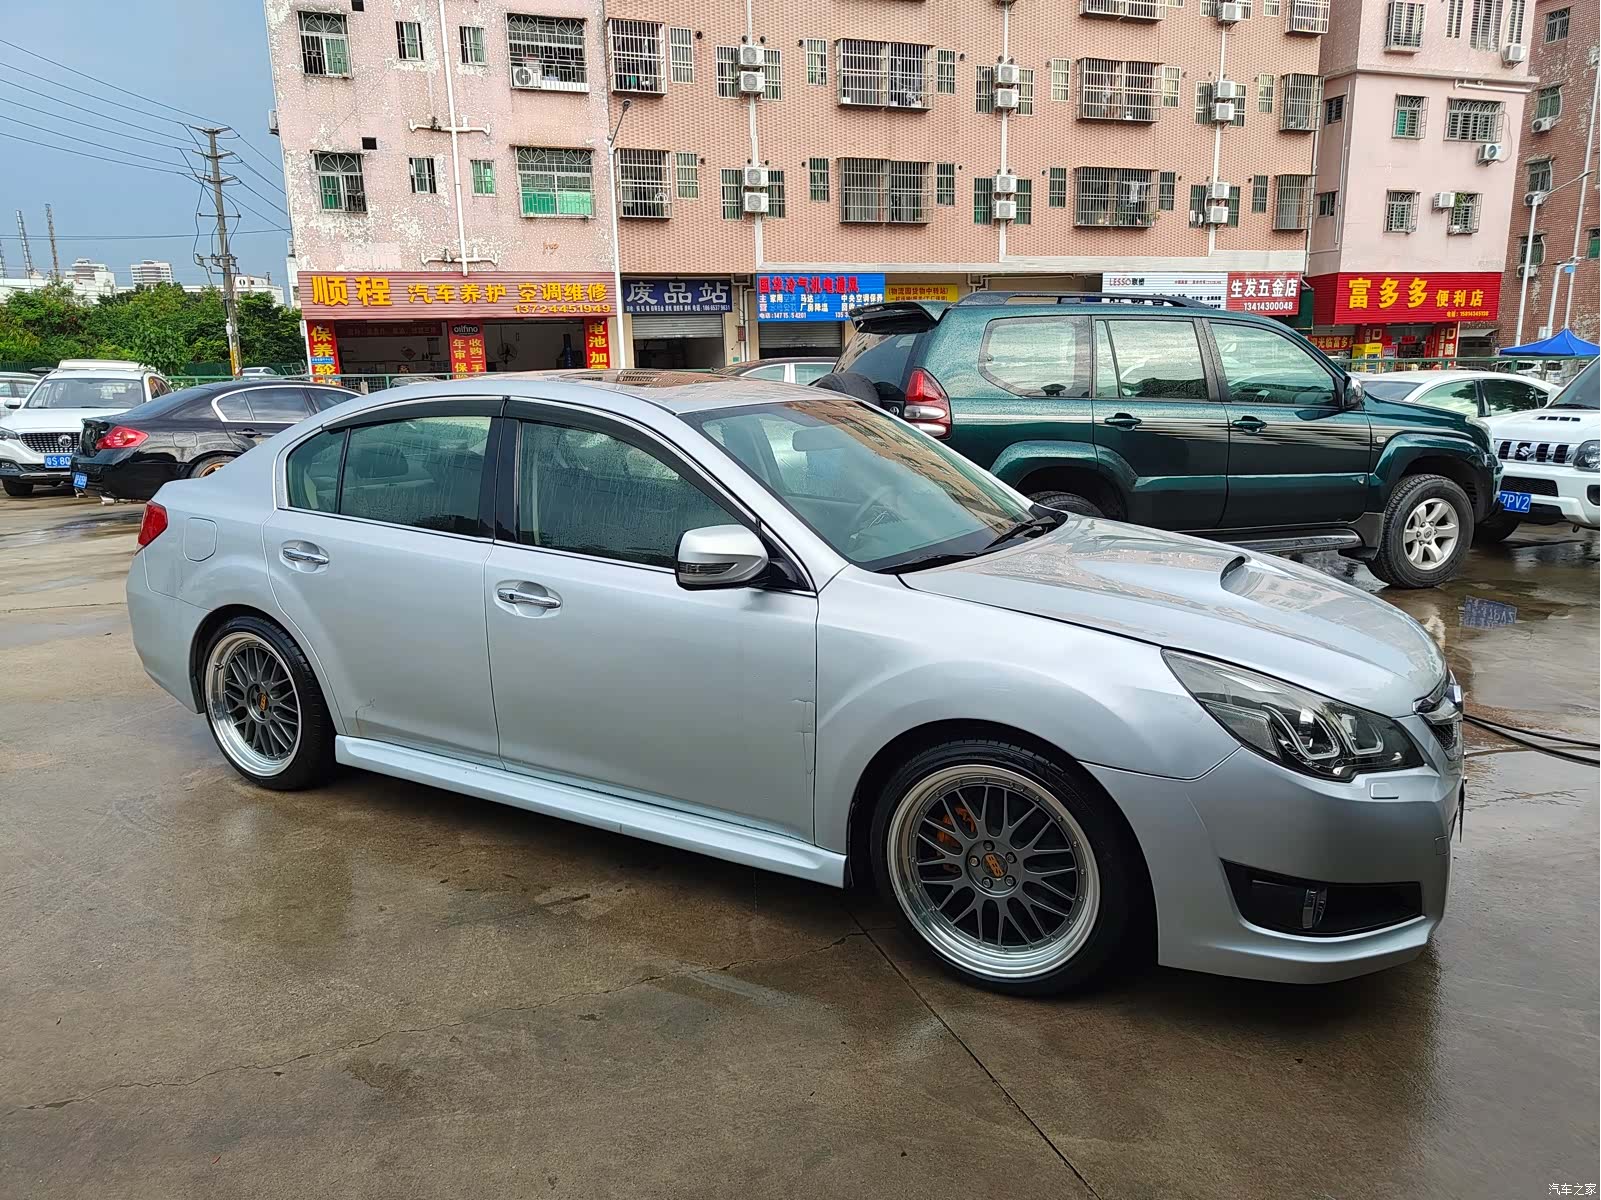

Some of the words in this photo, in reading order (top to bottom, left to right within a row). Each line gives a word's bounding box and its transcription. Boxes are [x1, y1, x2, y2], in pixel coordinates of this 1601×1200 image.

[311, 276, 393, 307] 顺程
[407, 283, 507, 304] 汽车养护
[517, 282, 608, 303] 空调维修
[626, 281, 729, 305] 废品站
[1230, 277, 1298, 298] 生发五金店
[1348, 277, 1428, 309] 富多多
[1436, 289, 1484, 308] 便利店
[513, 304, 611, 314] 13724451949
[1243, 302, 1293, 311] 13414300048
[1501, 493, 1530, 510] 7PV2
